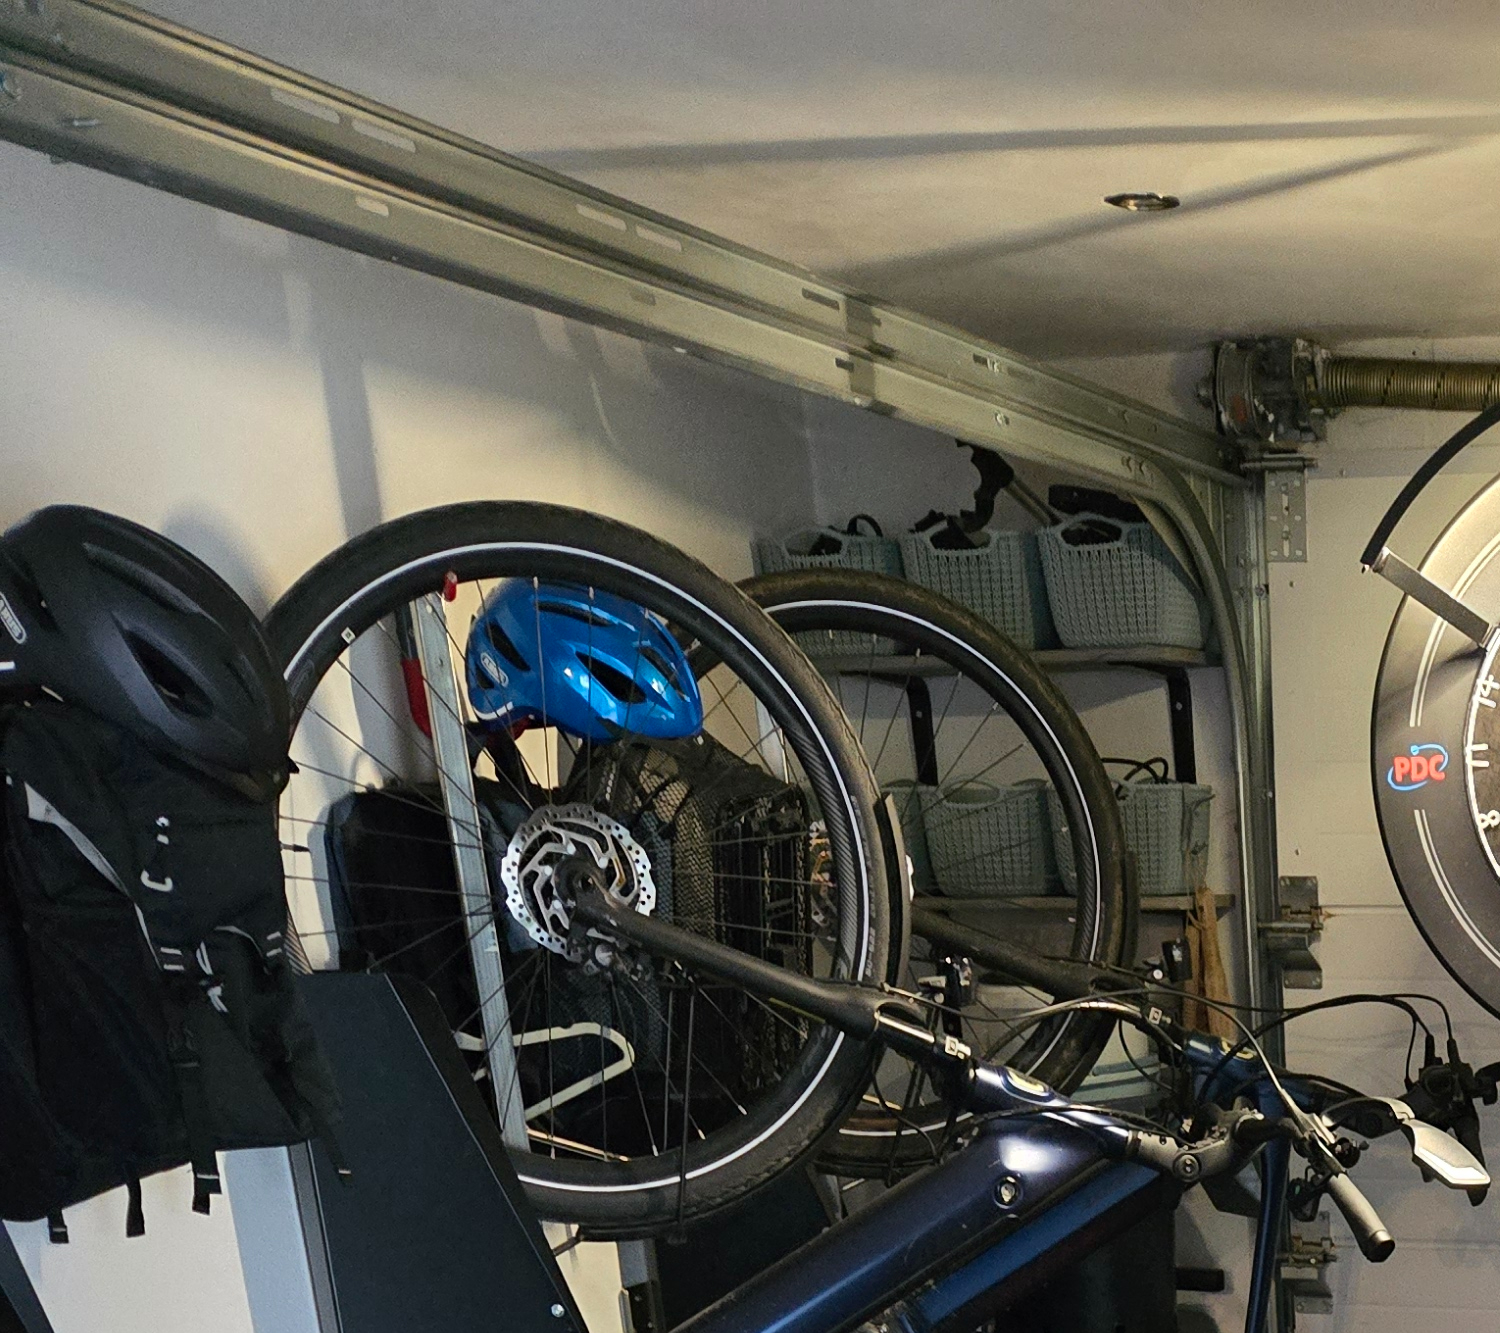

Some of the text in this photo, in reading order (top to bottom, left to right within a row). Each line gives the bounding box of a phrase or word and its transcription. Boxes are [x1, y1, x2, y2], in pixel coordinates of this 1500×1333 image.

[1478, 675, 1500, 708] 14
[1394, 754, 1445, 782] PDC
[1466, 743, 1490, 767] 11
[1478, 809, 1500, 829] 8
